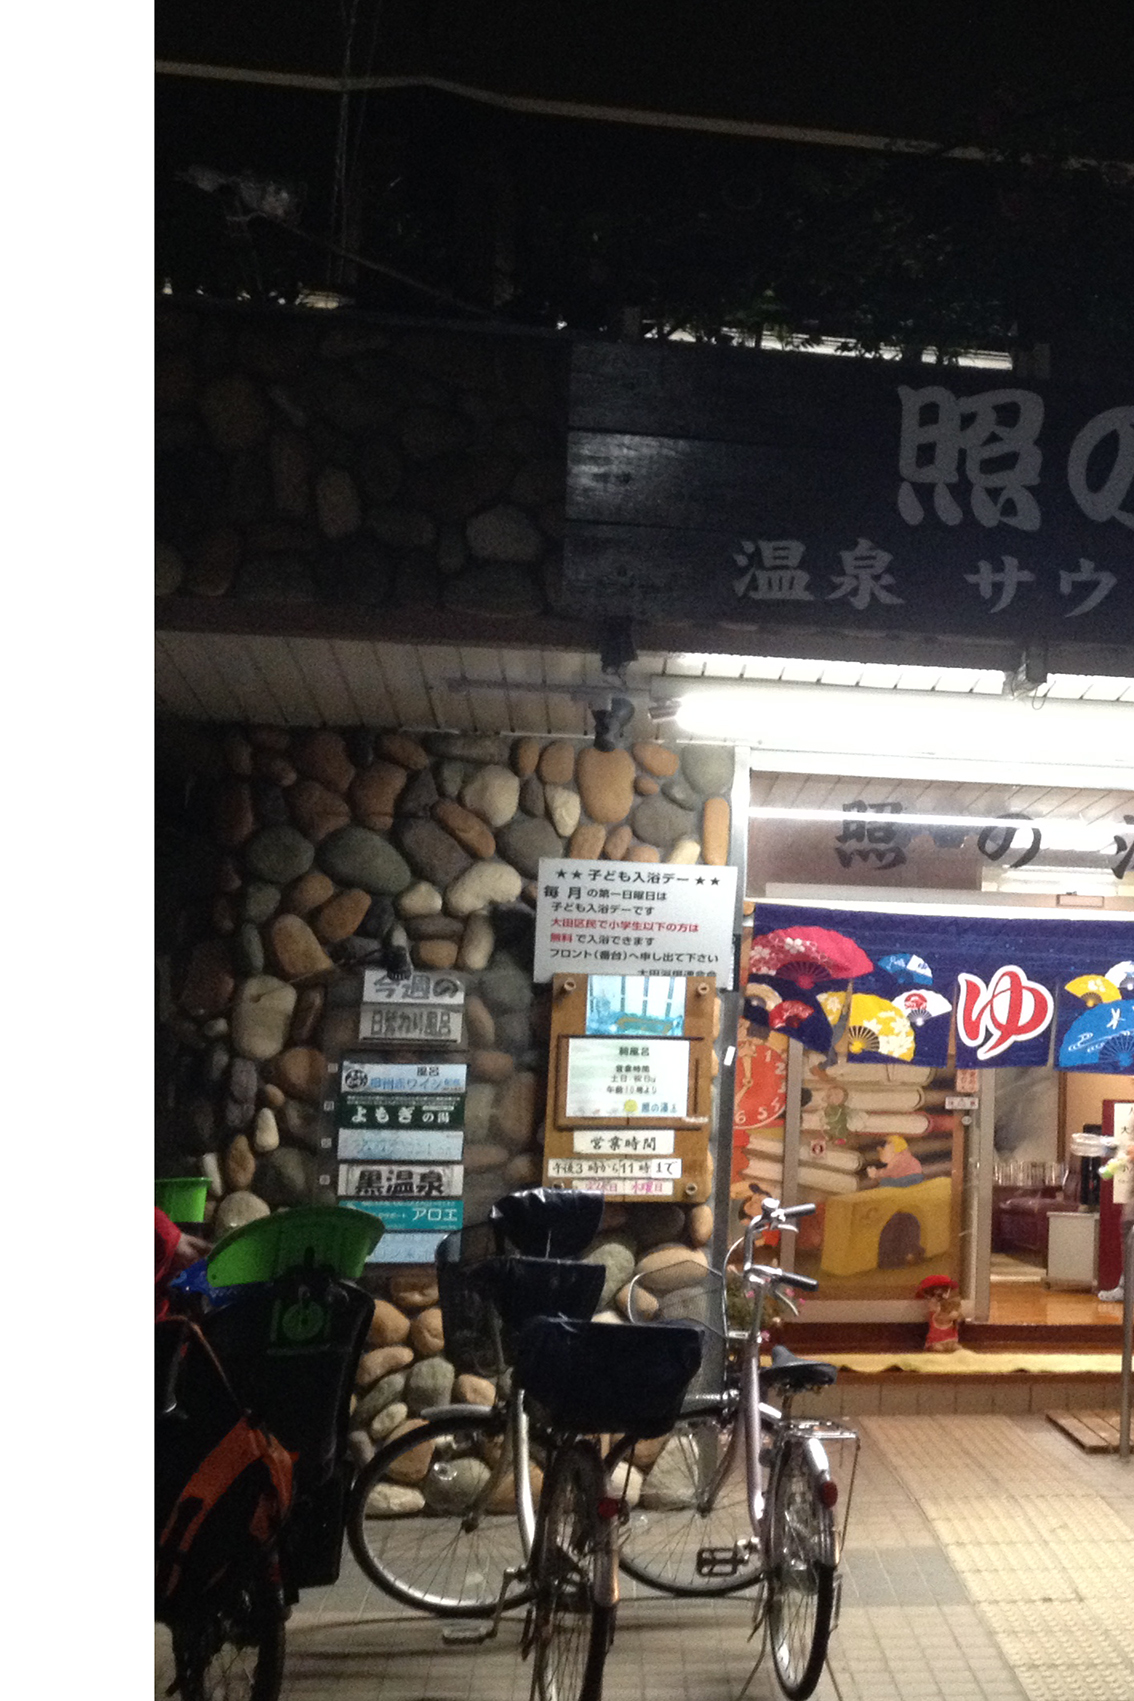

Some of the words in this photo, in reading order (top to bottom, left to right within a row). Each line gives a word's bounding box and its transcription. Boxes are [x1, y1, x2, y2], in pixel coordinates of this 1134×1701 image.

[732, 538, 904, 611] 温泉
[588, 868, 690, 885] 子ども入浴デー
[551, 902, 655, 916] 子ども入浴デーです
[551, 918, 700, 933] 大田区民で小学生以下の方は
[958, 966, 1053, 1060] ゆ
[590, 1136, 656, 1151] 営業時間
[355, 1170, 444, 1196] 黒温泉
[412, 1207, 457, 1221] アロエ
